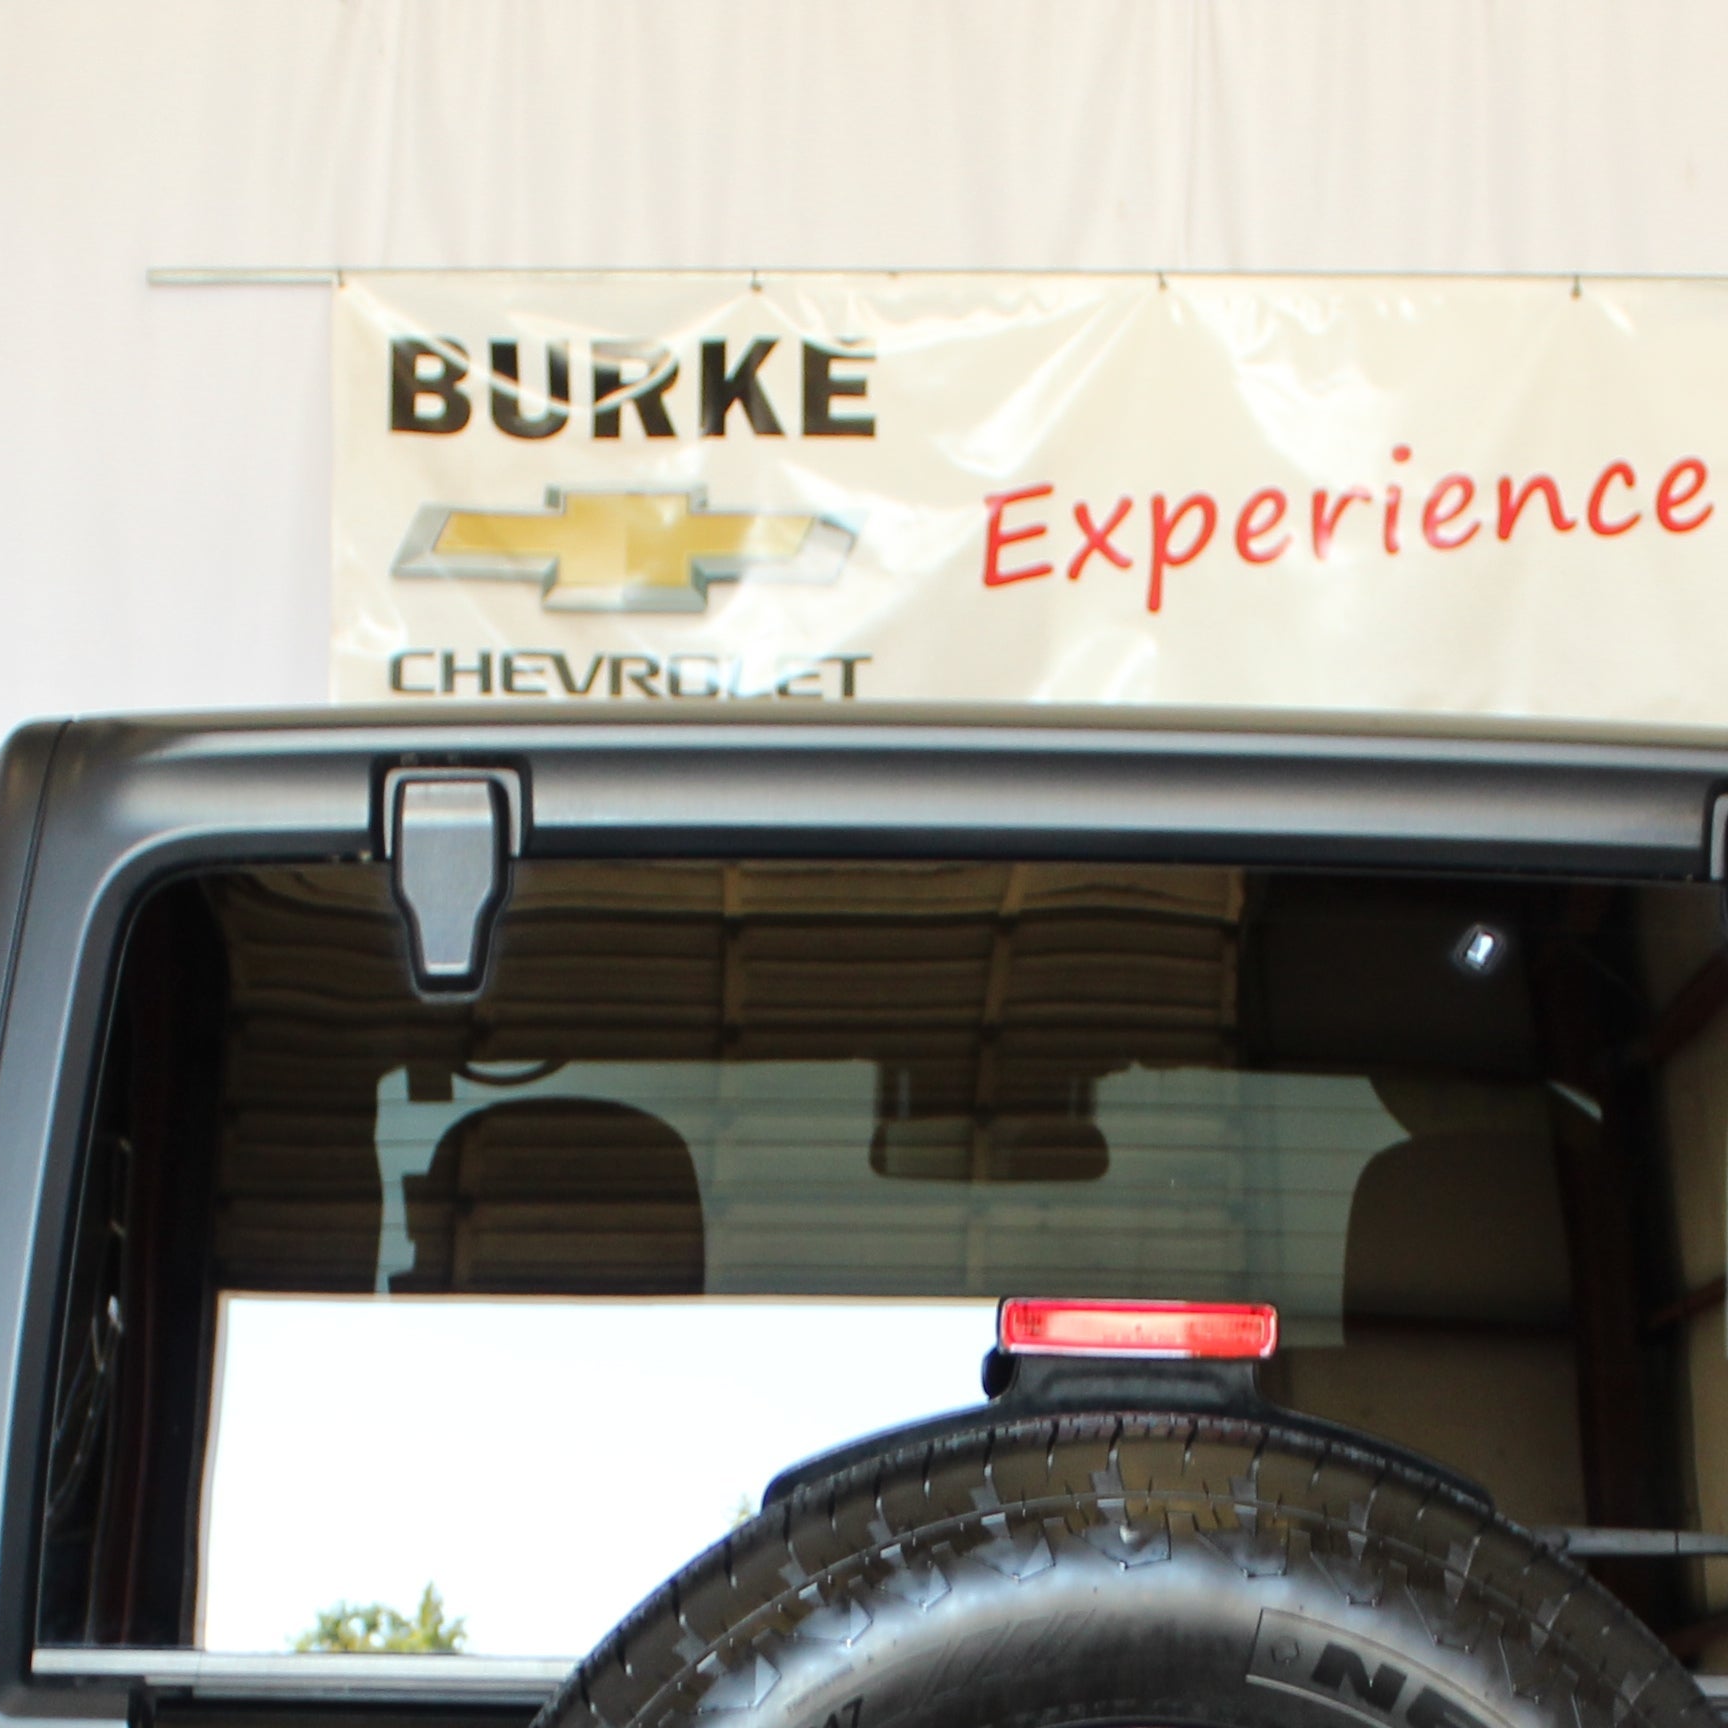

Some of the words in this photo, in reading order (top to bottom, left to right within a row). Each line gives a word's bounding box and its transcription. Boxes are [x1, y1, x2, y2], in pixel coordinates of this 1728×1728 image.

[388, 337, 877, 440] BURKE
[981, 442, 1715, 613] Experience
[388, 649, 874, 699] CHEVROLET
